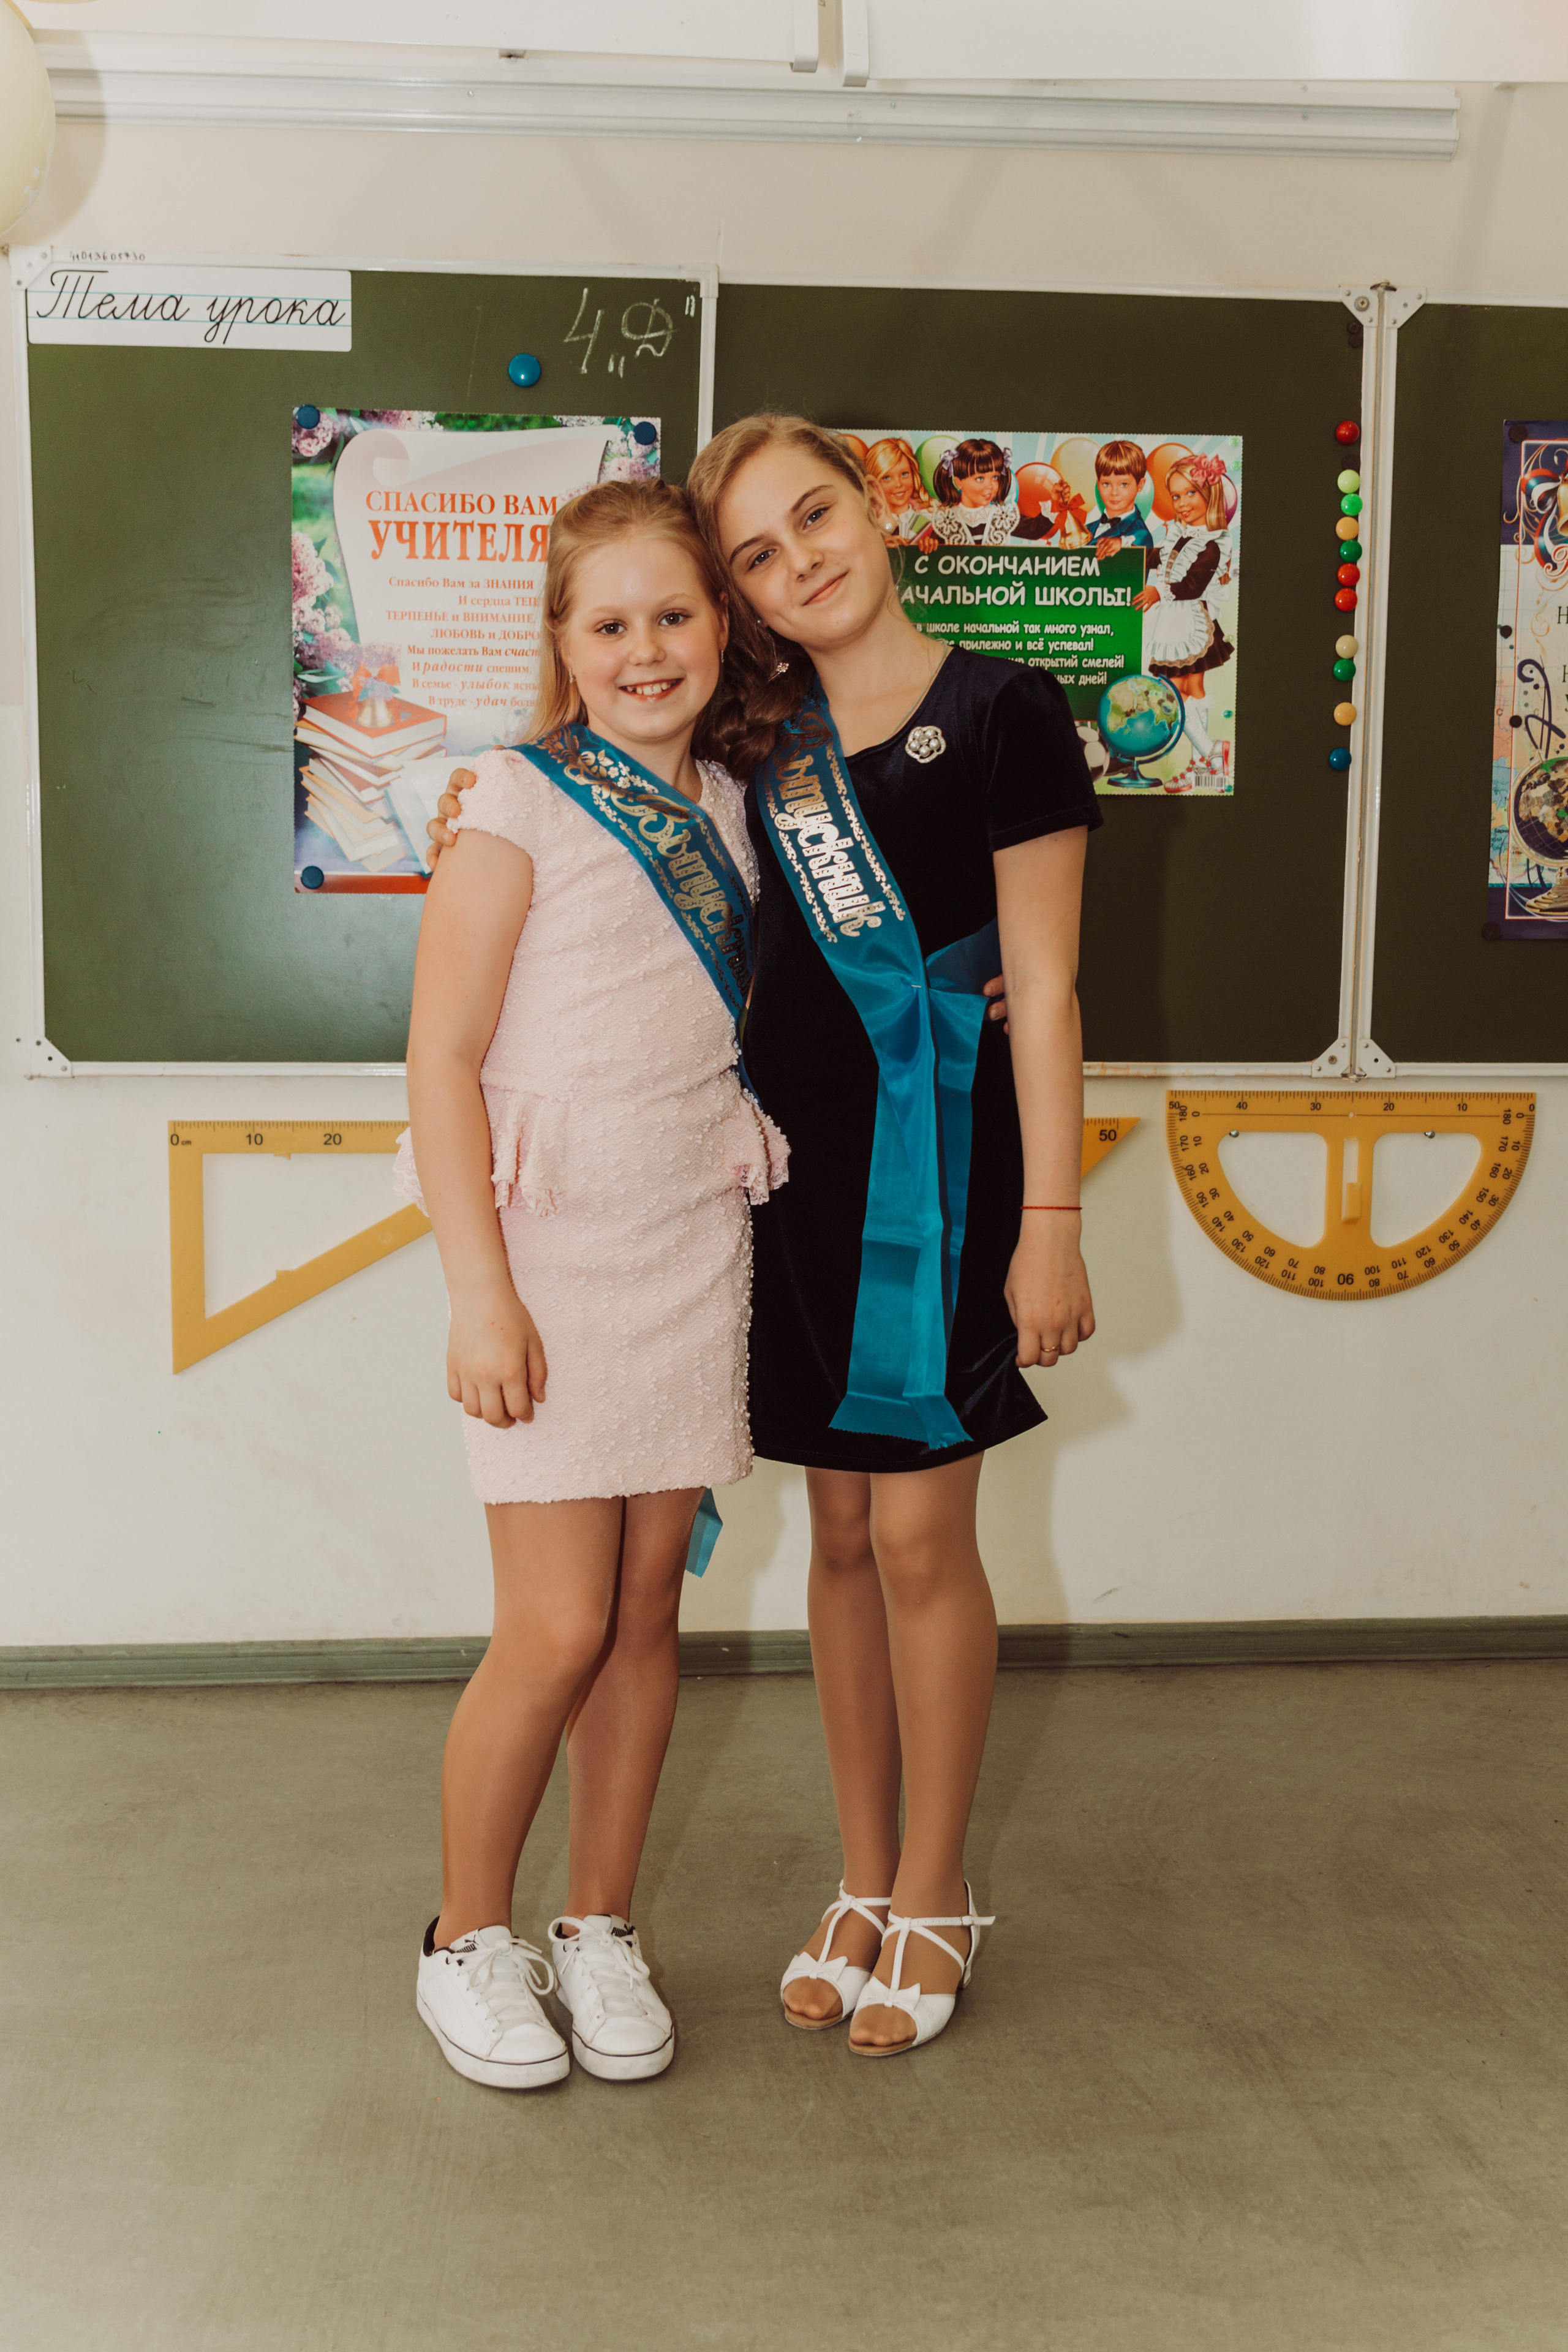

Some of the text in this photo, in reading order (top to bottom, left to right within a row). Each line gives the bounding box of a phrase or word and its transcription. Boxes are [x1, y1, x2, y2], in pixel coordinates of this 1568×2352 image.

[37, 270, 345, 344] Тема урока
[366, 490, 558, 516] СПАСИБО ВАМ
[368, 520, 550, 562] УЧИТЕЛЯ
[914, 555, 1100, 576] С ОКОНЧАНИЕМ
[389, 576, 439, 587] Спасибо
[443, 578, 465, 588] Вам
[483, 579, 533, 589] ЗНАНИЯ
[897, 581, 1131, 606] АЧАЛЬНОЙ ШКОЛЫ!
[458, 595, 467, 605] И
[470, 597, 510, 608] сердца
[386, 611, 448, 621] ТЕРПЕНЬЕ
[430, 629, 484, 639] ЛЮБОВЬ
[926, 623, 960, 633] школе
[963, 620, 1020, 633] начальной
[1023, 624, 1041, 634] так
[1044, 624, 1077, 635] много
[1080, 624, 1114, 638] узнал,
[408, 645, 424, 654] Мы
[428, 647, 478, 656] пожелать
[481, 646, 502, 656] Вам
[1015, 641, 1023, 650] и
[1027, 638, 1044, 651] всё
[1047, 638, 1094, 655] успевал!
[412, 662, 420, 671] И
[423, 661, 483, 674] радости
[1028, 654, 1078, 670] открытий
[1082, 654, 1125, 668] смелей!
[412, 678, 419, 688] В
[458, 678, 510, 692] улыбок
[1079, 671, 1107, 686] дней!
[428, 695, 435, 704] В
[437, 698, 467, 707] труде
[474, 696, 507, 709] удач
[773, 712, 886, 938] Выпускник
[611, 788, 751, 997] Выпускни
[1179, 1105, 1188, 1121] 180
[1457, 1103, 1468, 1112] 10
[1502, 1108, 1512, 1125] 180
[170, 1134, 179, 1145] 0
[246, 1134, 263, 1145] 10
[323, 1134, 342, 1145] 20
[1099, 1129, 1117, 1141] 50
[1180, 1135, 1189, 1152] 170
[1193, 1136, 1202, 1147] 10
[1498, 1136, 1509, 1152] 170
[1511, 1140, 1520, 1152] 10
[1186, 1164, 1197, 1180] 160
[1199, 1163, 1209, 1175] 20
[1489, 1163, 1501, 1178] 160
[1502, 1167, 1512, 1180] 20
[1196, 1192, 1209, 1208] 150
[1208, 1188, 1220, 1200] 30
[1476, 1187, 1489, 1203] 150
[1488, 1194, 1499, 1207] 30
[1224, 1211, 1234, 1222] 40
[1459, 1210, 1473, 1224] 140
[1212, 1216, 1226, 1232] 140
[1470, 1219, 1480, 1231] 40
[1242, 1231, 1254, 1242] 50
[1439, 1229, 1454, 1243] 130
[1231, 1238, 1246, 1253] 130
[1264, 1246, 1276, 1257] 60
[1415, 1245, 1431, 1258] 120
[1449, 1240, 1460, 1251] 50
[1254, 1256, 1270, 1269] 120
[1288, 1258, 1299, 1268] 70
[1391, 1257, 1407, 1269] 110
[1423, 1257, 1436, 1268] 60
[1281, 1269, 1296, 1281] 110
[1314, 1265, 1325, 1275] 80
[1365, 1265, 1380, 1275] 100
[1396, 1270, 1409, 1280] 70
[1308, 1278, 1324, 1287] 100
[1337, 1273, 1354, 1285] 90
[1369, 1278, 1380, 1287] 80
